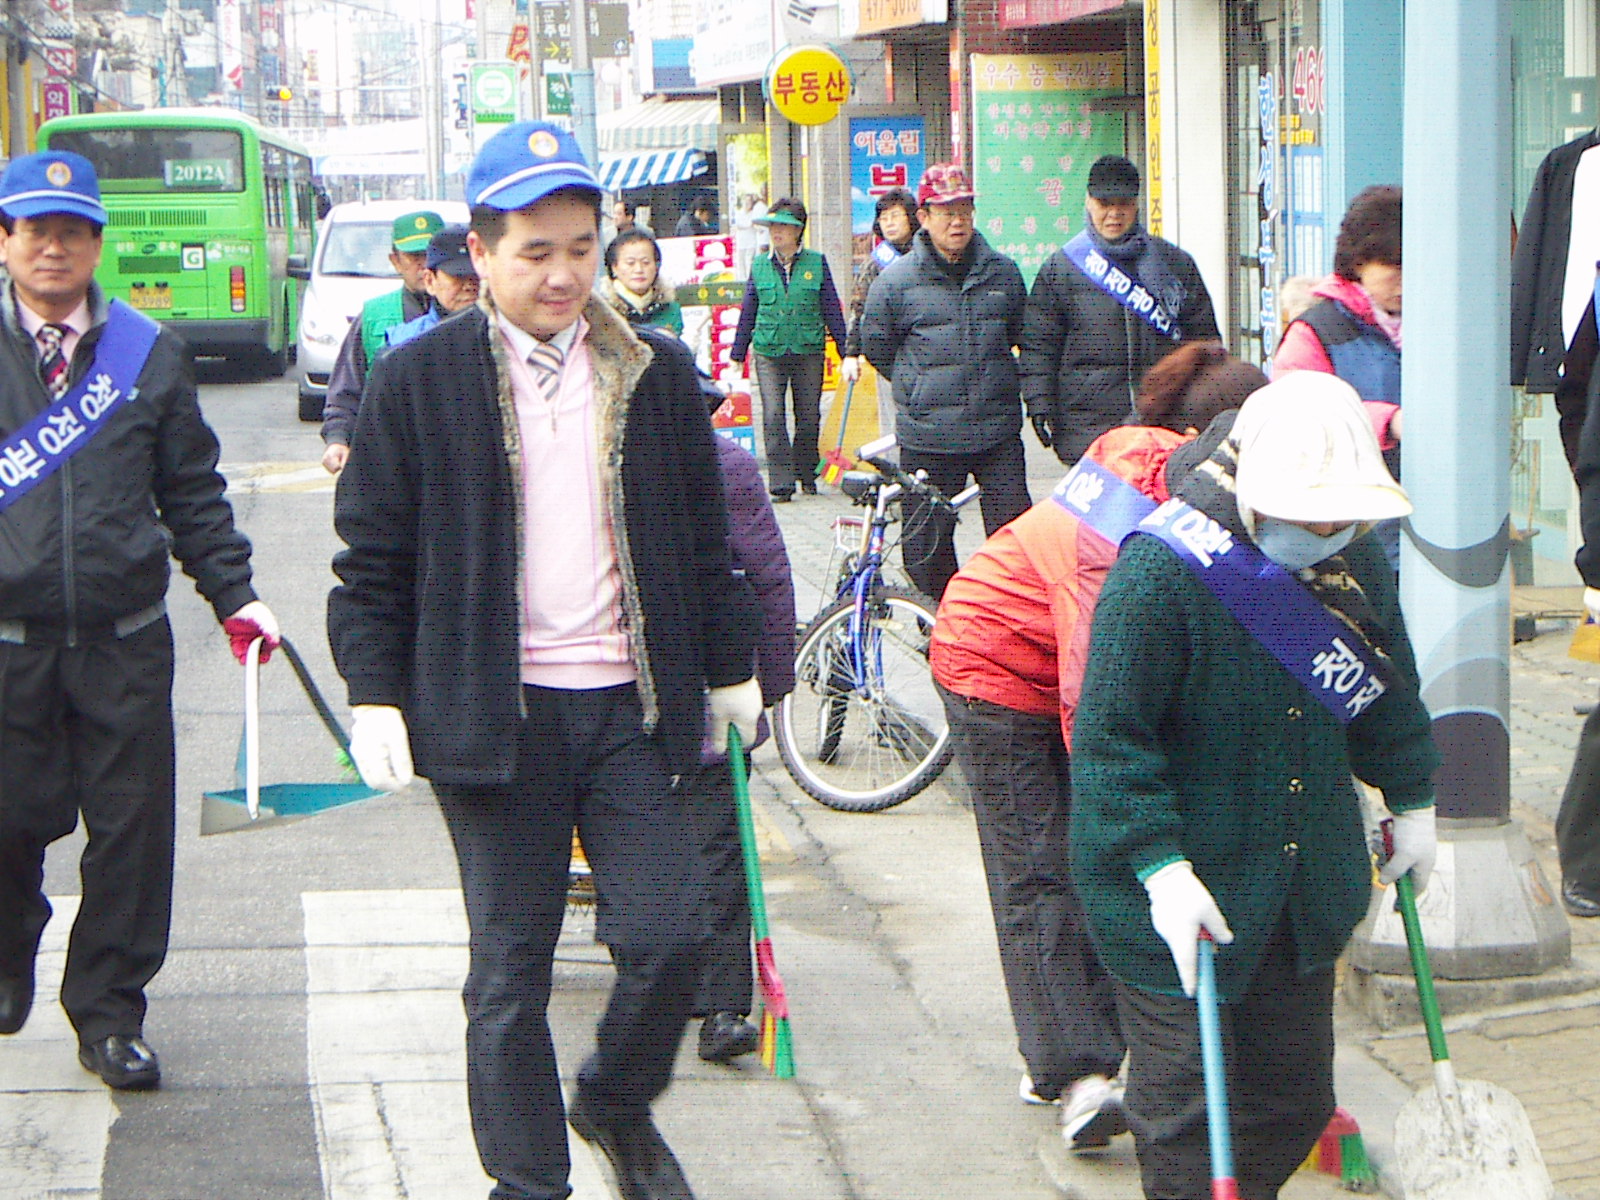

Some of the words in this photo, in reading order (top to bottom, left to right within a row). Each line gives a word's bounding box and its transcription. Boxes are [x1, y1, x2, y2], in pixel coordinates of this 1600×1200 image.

[775, 71, 845, 105] 부동산
[981, 61, 1021, 89] 우수
[853, 130, 921, 157] 어울림
[175, 165, 225, 180] 2012A
[187, 251, 201, 265] G
[0, 373, 122, 492] 청정광
